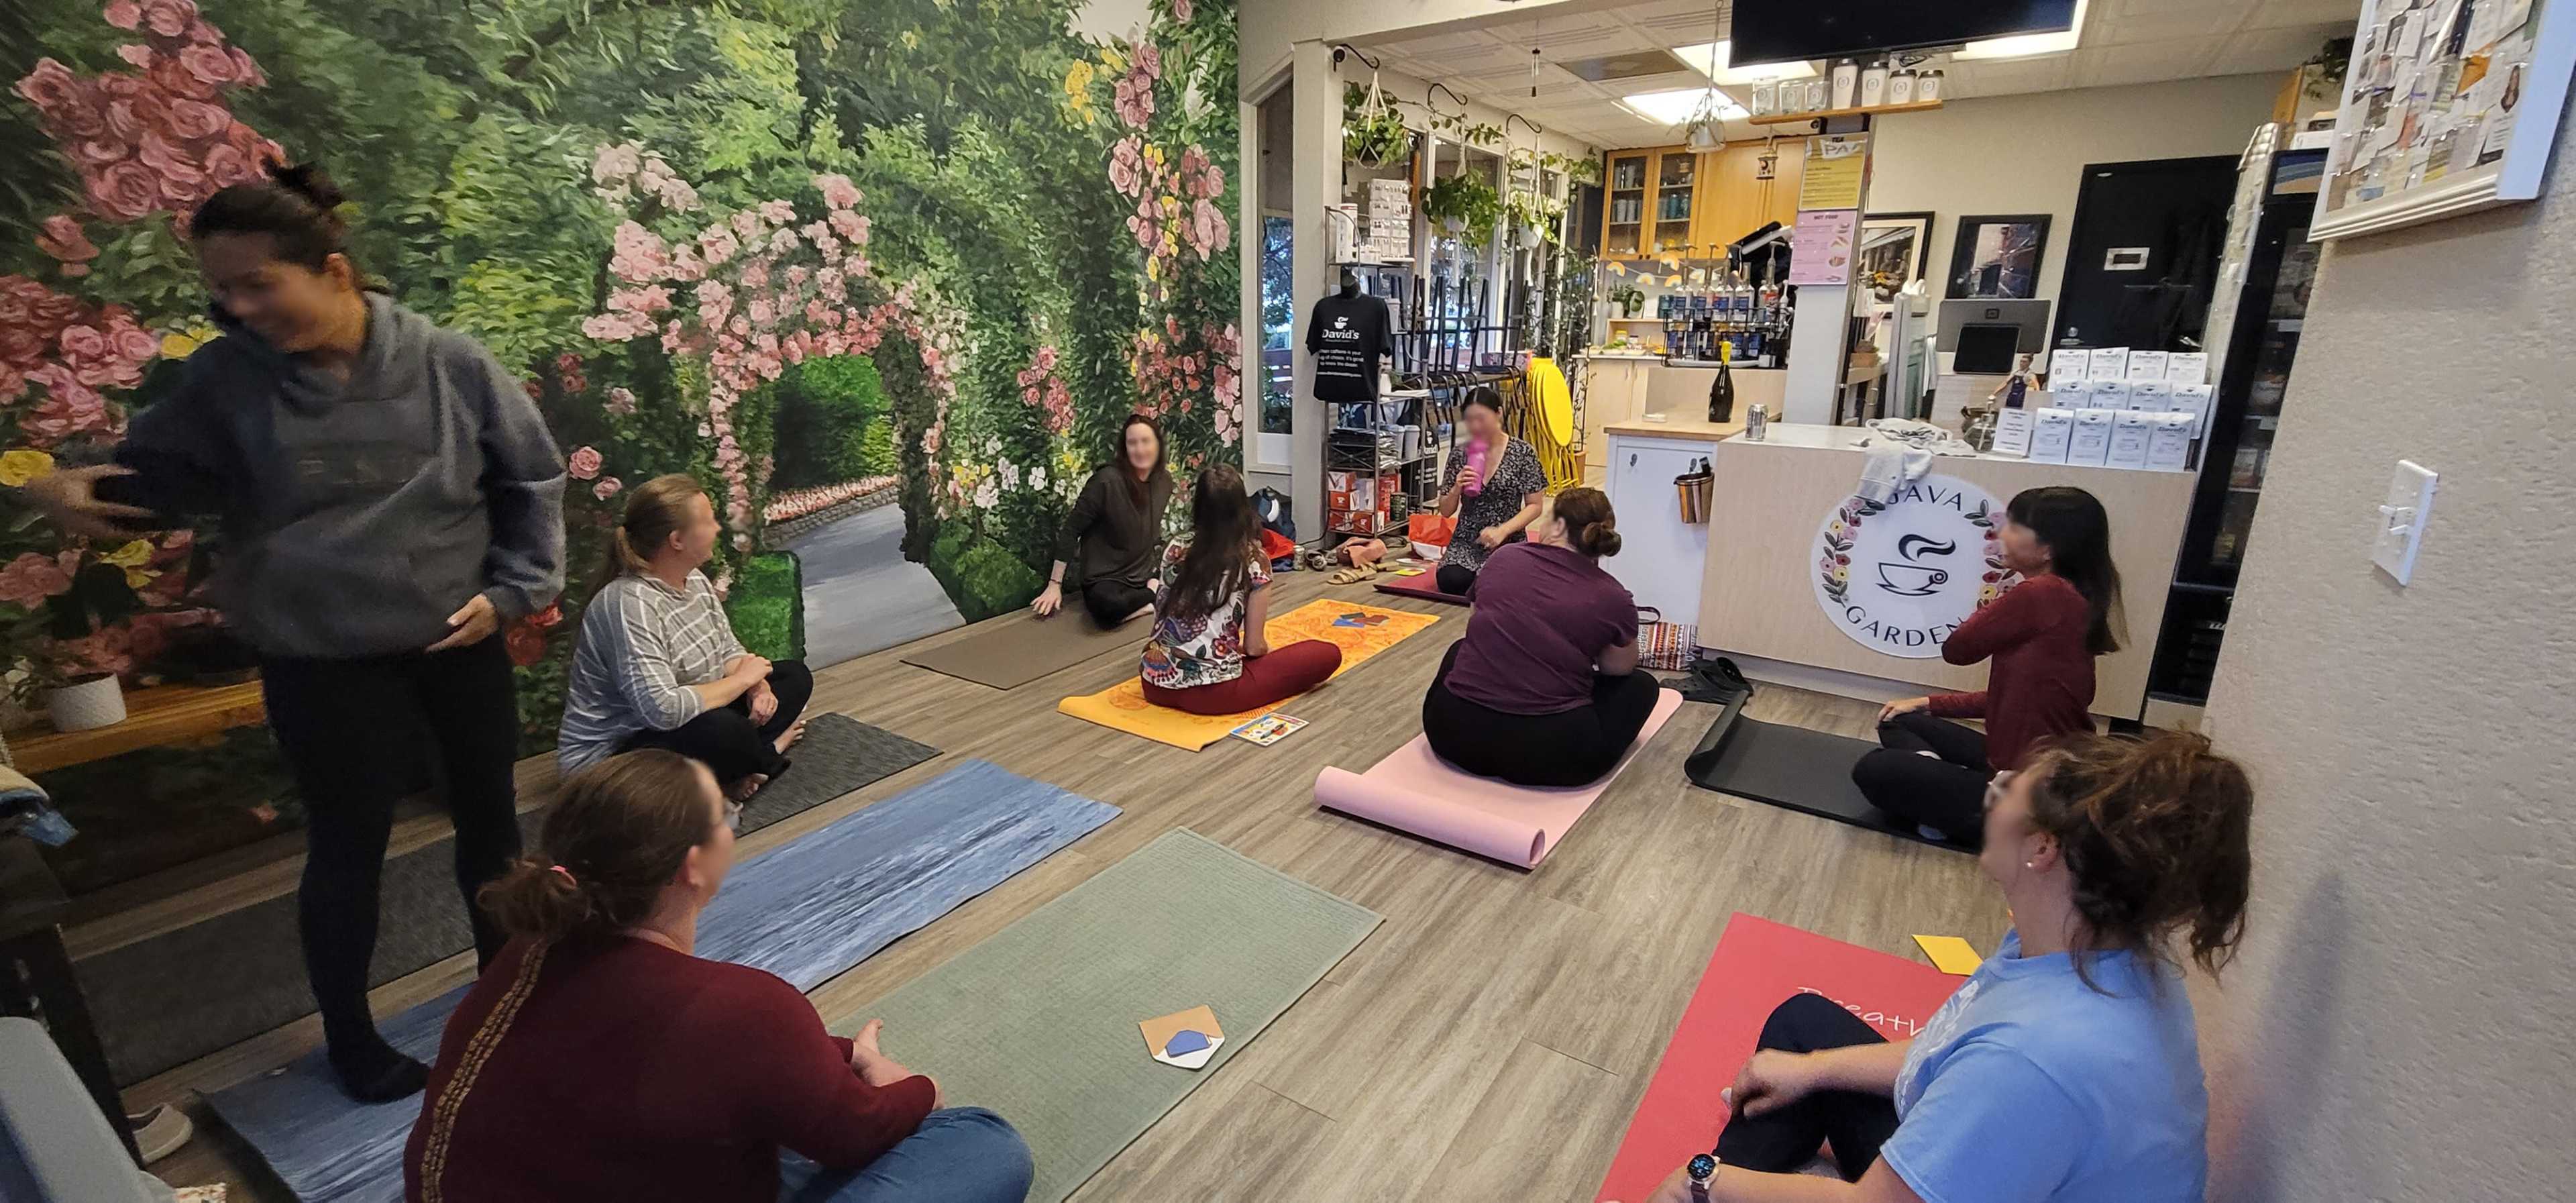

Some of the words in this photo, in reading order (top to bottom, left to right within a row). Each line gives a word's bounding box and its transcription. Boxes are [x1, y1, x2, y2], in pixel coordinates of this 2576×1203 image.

[1322, 329, 1359, 339] David's
[1888, 485, 1962, 511] JAVA
[1798, 987, 1925, 1037] eath
